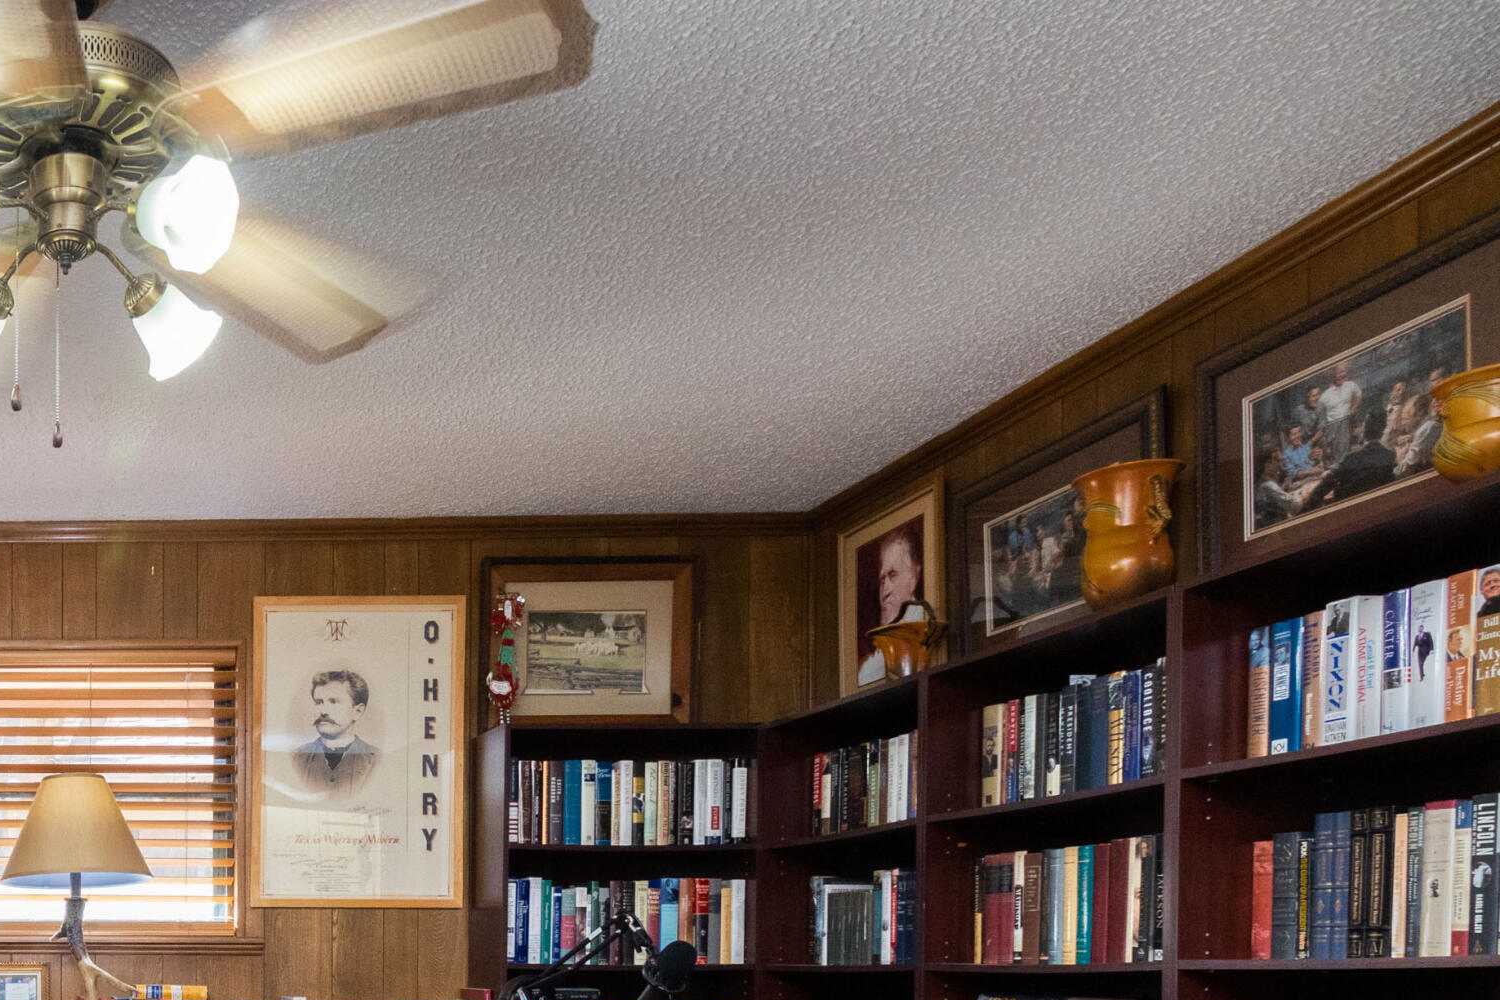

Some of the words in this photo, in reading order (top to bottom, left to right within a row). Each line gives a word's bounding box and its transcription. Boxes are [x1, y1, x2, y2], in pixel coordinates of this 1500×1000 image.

[1383, 610, 1395, 661] CARTER
[1143, 672, 1154, 733] COOLIDGE
[1251, 671, 1267, 737] EISENHOWER
[422, 678, 440, 852] HENRY
[1409, 811, 1419, 850] LINCOLN
[1475, 802, 1496, 857] LINCOLN
[1156, 873, 1164, 929] JACKSON
